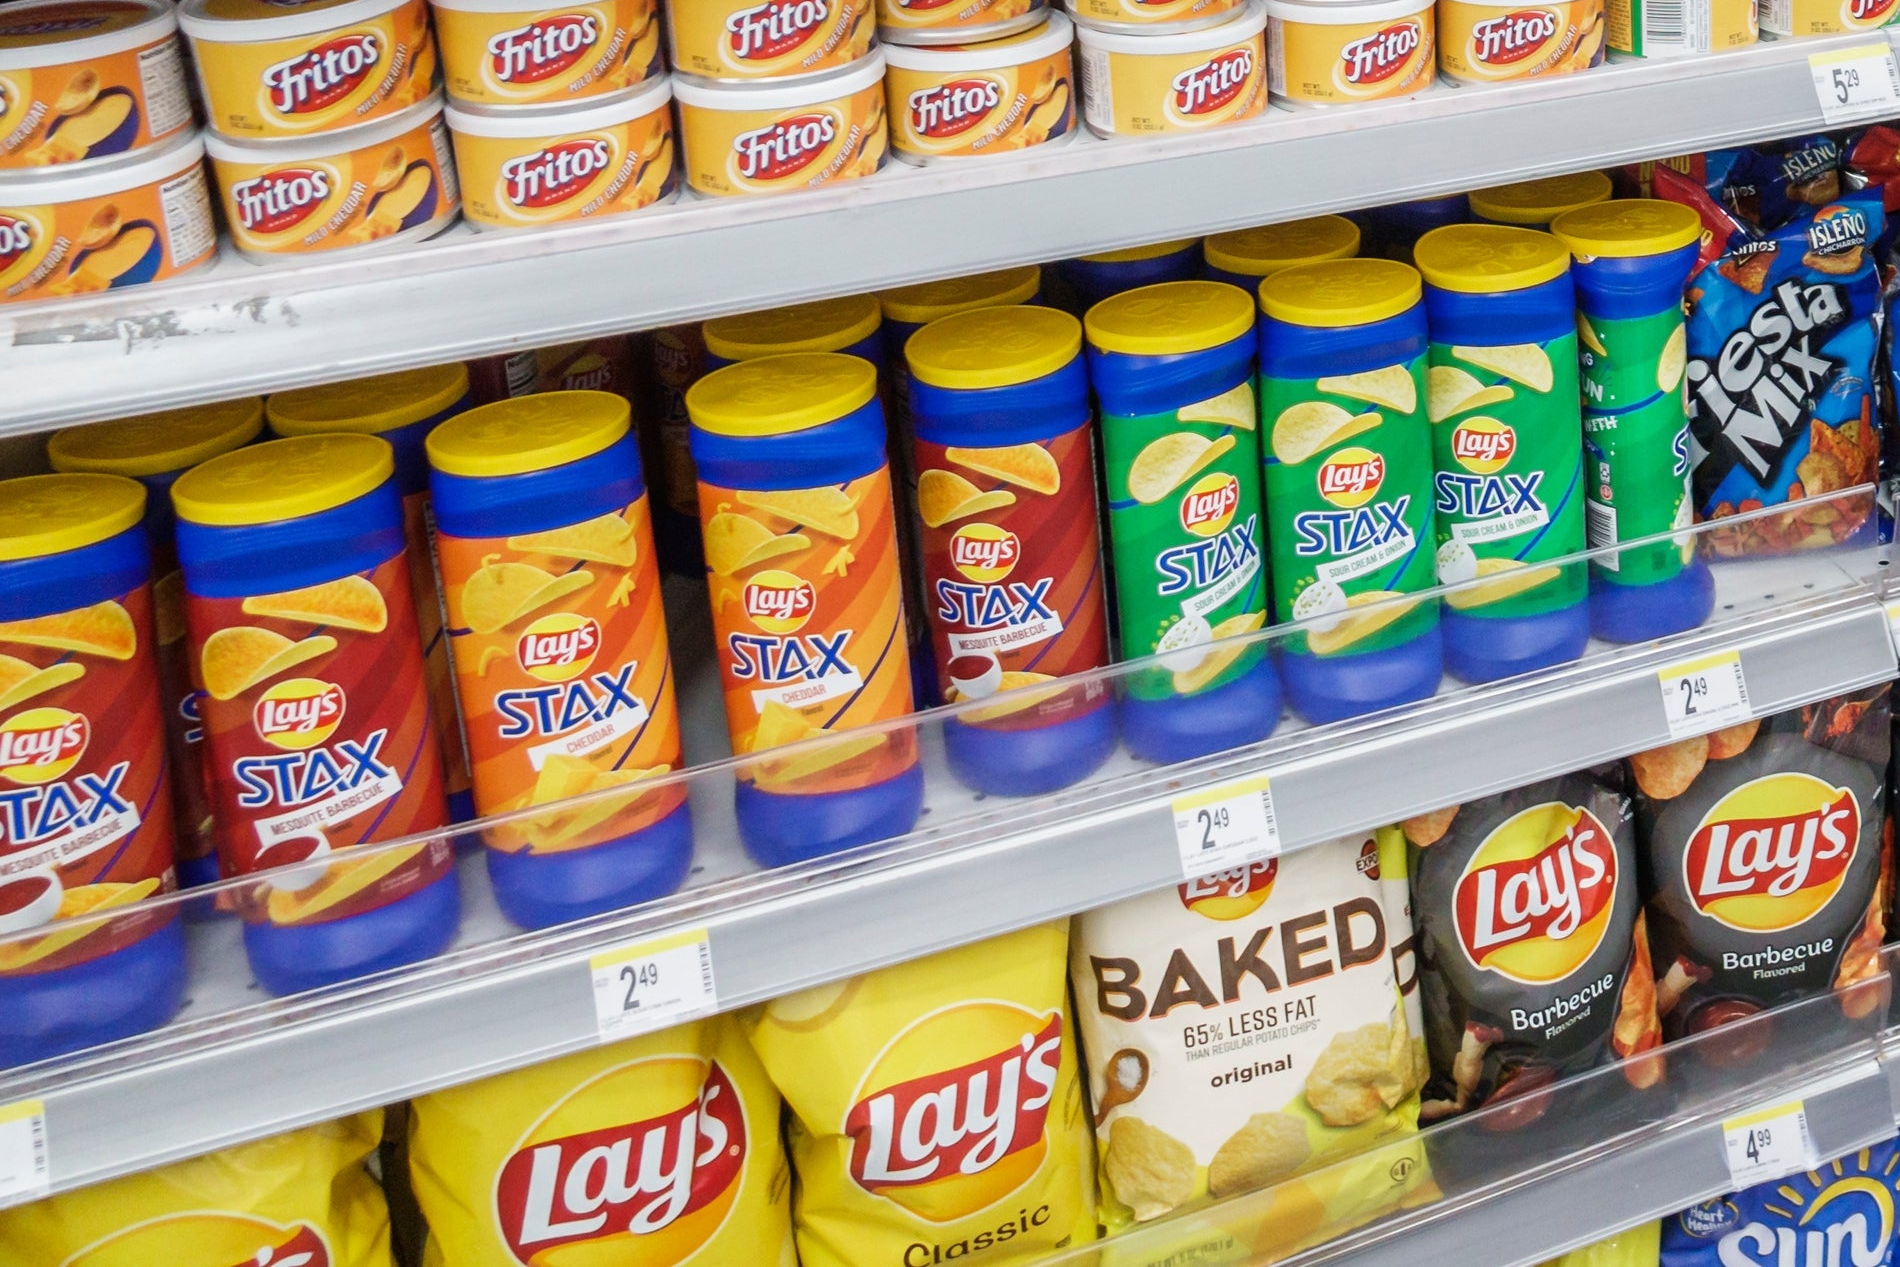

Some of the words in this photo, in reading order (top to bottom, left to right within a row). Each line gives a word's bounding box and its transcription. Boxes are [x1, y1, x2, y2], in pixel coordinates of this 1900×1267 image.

[959, 4, 980, 21] MILD
[264, 33, 380, 114] Fritos
[492, 15, 597, 81] Fritos
[569, 72, 593, 92] MILD
[594, 27, 626, 76] CHEDDAR
[232, 168, 328, 225] Fritos
[305, 226, 327, 245] MILD
[329, 181, 367, 232] CHEDDAR
[1809, 212, 1866, 250] ISLEÑO
[1723, 335, 1833, 478] Mix
[1322, 460, 1382, 496] Lay's
[955, 533, 1017, 568] Lay's
[1295, 496, 1411, 555] STAX
[1328, 564, 1351, 579] SOUR
[1352, 554, 1375, 572] CREAM
[1384, 541, 1406, 557] ONION
[749, 584, 809, 620] Lay's
[938, 577, 1054, 628] STAX
[524, 624, 595, 667] Lay's
[728, 629, 855, 683] STAX
[958, 635, 998, 653] MESQUITE
[999, 623, 1049, 646] BARBECUE
[261, 691, 340, 734] Lay's
[498, 662, 641, 738] STAX
[782, 684, 827, 704] CHEDDAR
[566, 725, 616, 754] CHEDDAR
[234, 729, 388, 807] STAX
[270, 808, 324, 836] MESQUITE
[325, 781, 384, 817] BARBECUE
[62, 818, 122, 860] BARBECUE
[1699, 801, 1850, 904] Lay's
[1474, 826, 1605, 948] Lay's
[1090, 897, 1386, 1022] BAKED
[1722, 938, 1833, 972] Barbecue
[1754, 963, 1805, 980] Flavored
[1183, 1022, 1223, 1047] 65%
[1229, 1008, 1277, 1037] LESS
[1285, 996, 1316, 1024] FAT
[1511, 973, 1614, 1031] Barbecue
[1186, 1050, 1210, 1062] THAN
[1212, 1038, 1253, 1056] REGULAR
[1256, 1029, 1288, 1046] POTATO
[1211, 1055, 1293, 1088] original
[864, 1034, 1061, 1181] Lay's
[519, 1084, 733, 1244] Lay's
